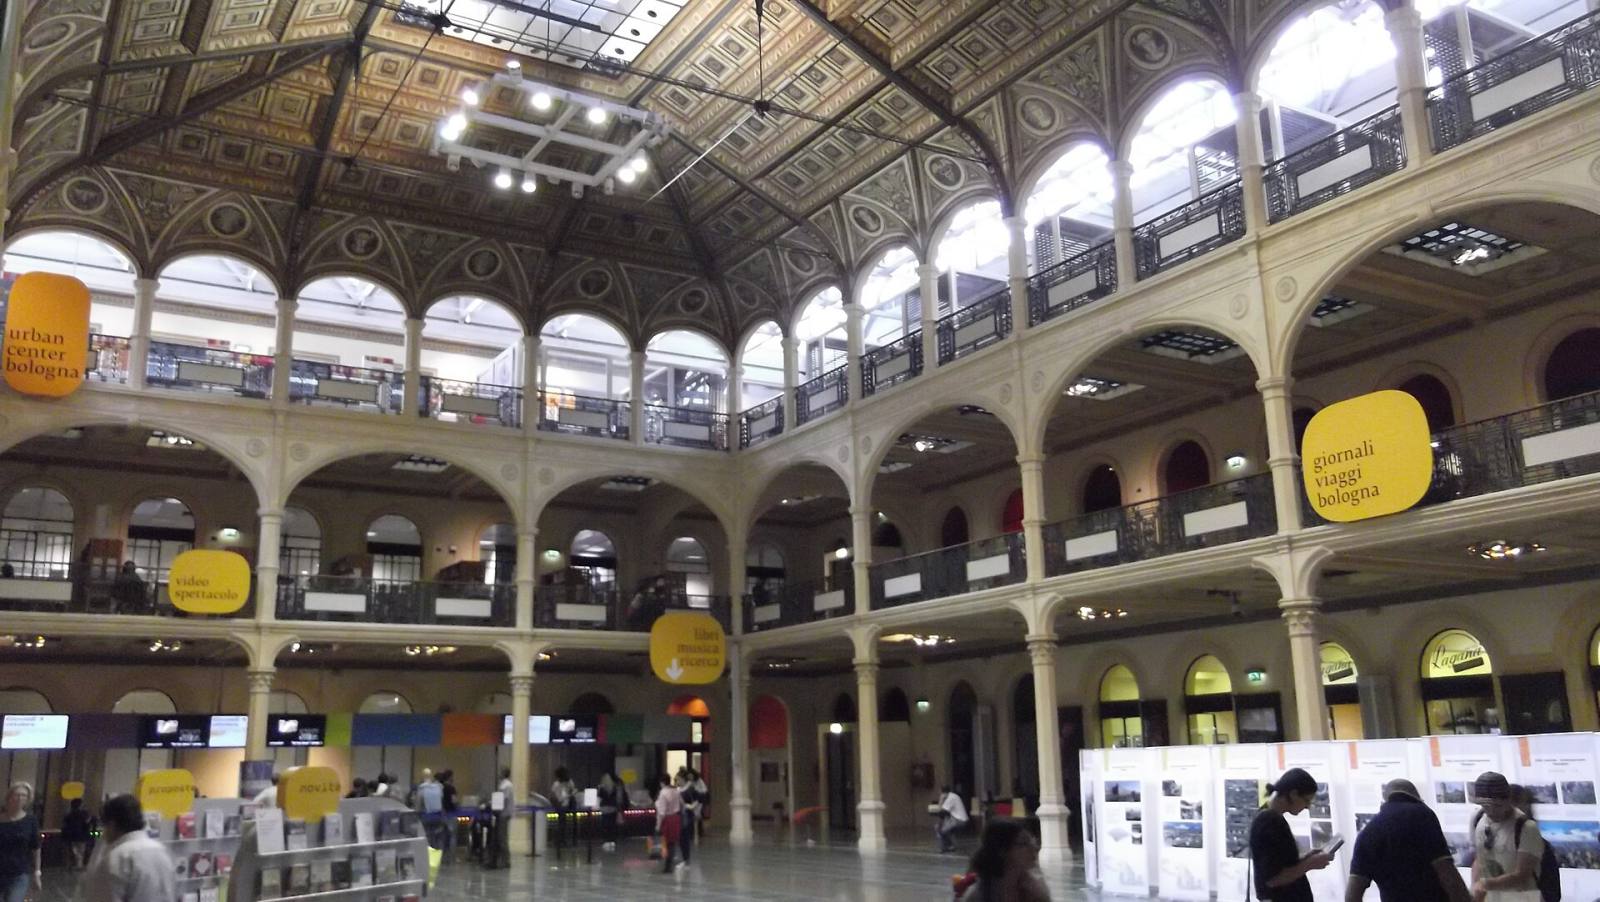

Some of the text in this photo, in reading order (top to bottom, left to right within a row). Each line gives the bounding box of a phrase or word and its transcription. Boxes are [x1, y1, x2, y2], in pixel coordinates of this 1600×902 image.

[9, 327, 64, 345] urban
[7, 344, 67, 361] center
[6, 357, 80, 381] bologna
[1313, 440, 1375, 474] giornali
[1315, 463, 1362, 488] viaggi
[1317, 485, 1381, 508] bologna
[176, 576, 210, 586] video
[175, 588, 240, 602] spettacolo
[694, 627, 720, 641] libri
[677, 643, 720, 654] musica
[679, 657, 720, 668] ricerca
